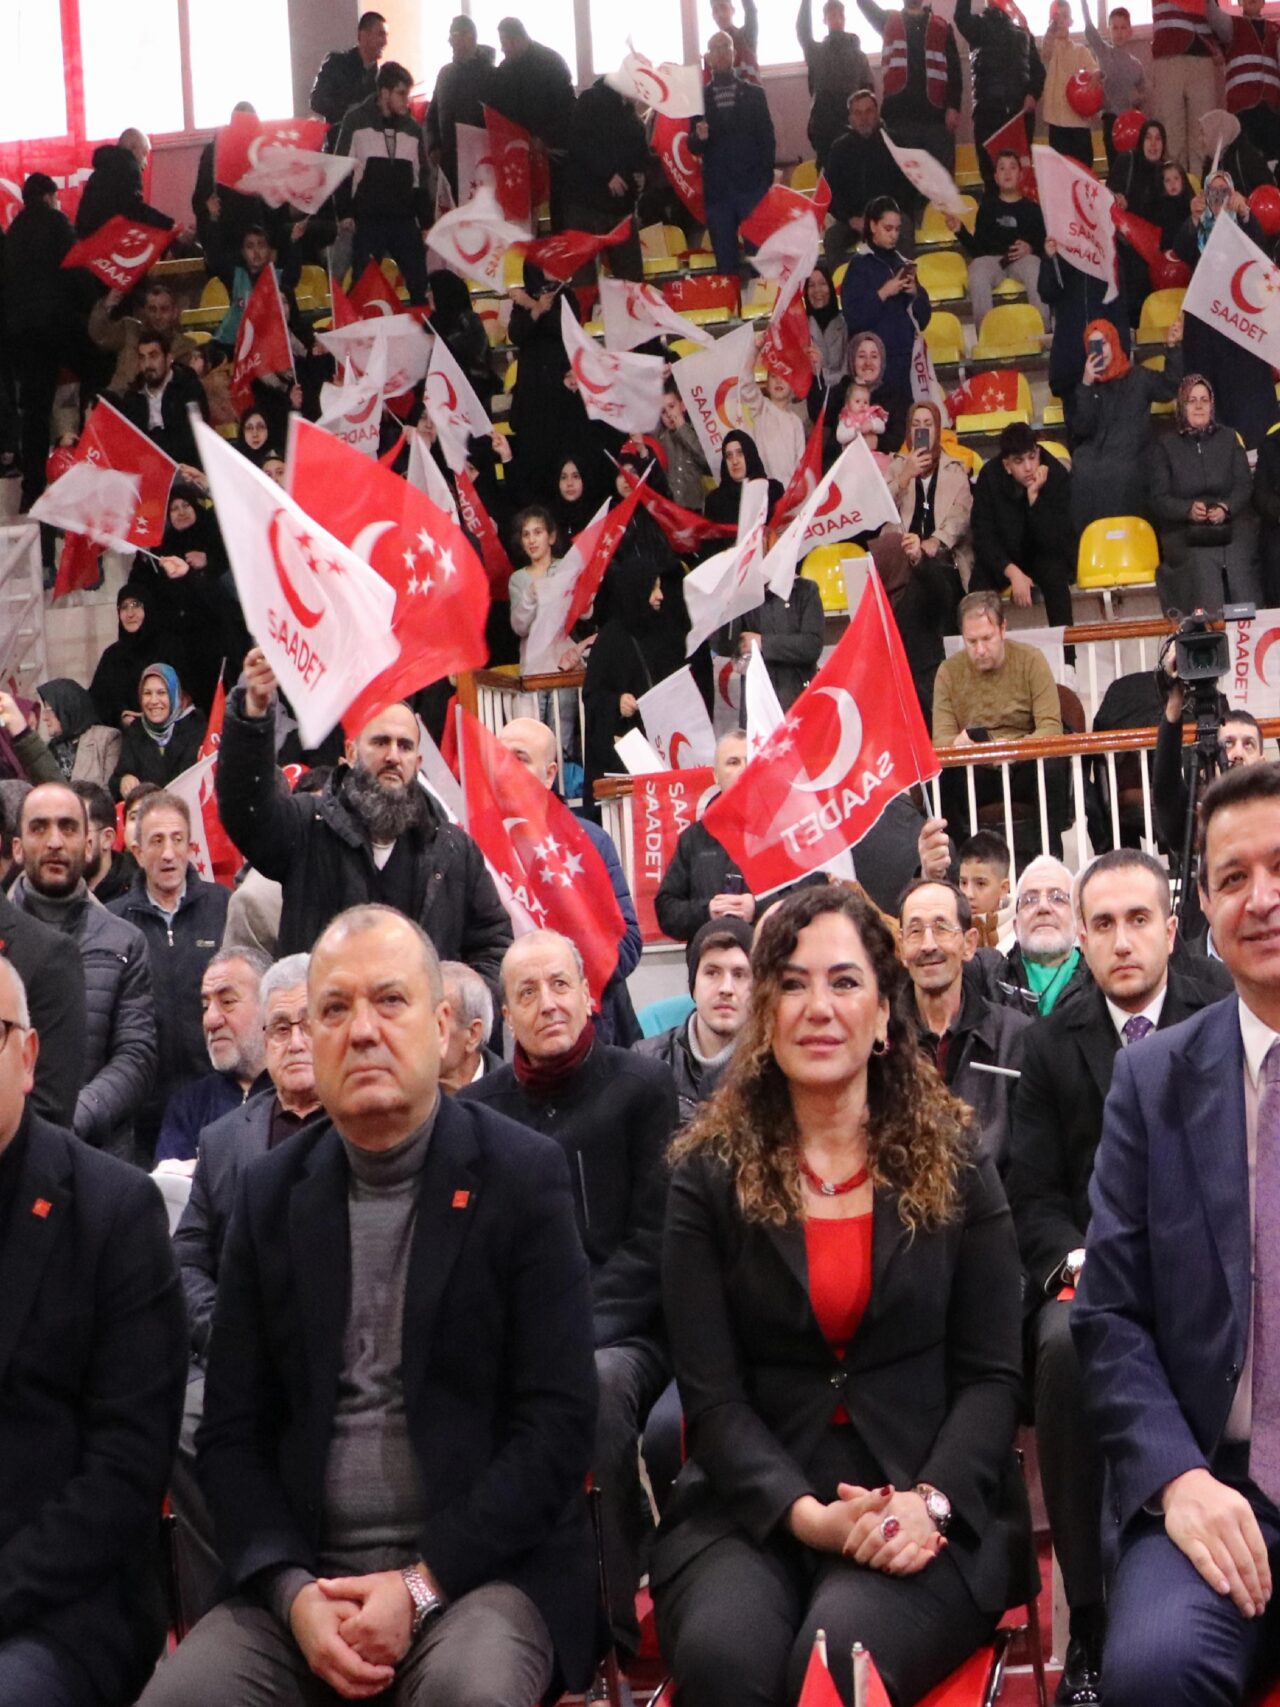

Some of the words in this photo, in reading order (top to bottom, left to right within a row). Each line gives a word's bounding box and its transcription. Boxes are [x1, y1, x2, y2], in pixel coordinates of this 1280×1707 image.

[1210, 299, 1269, 344] SAADET
[913, 352, 930, 395] ADET
[268, 608, 327, 693] SAADET
[668, 782, 692, 835] SAA
